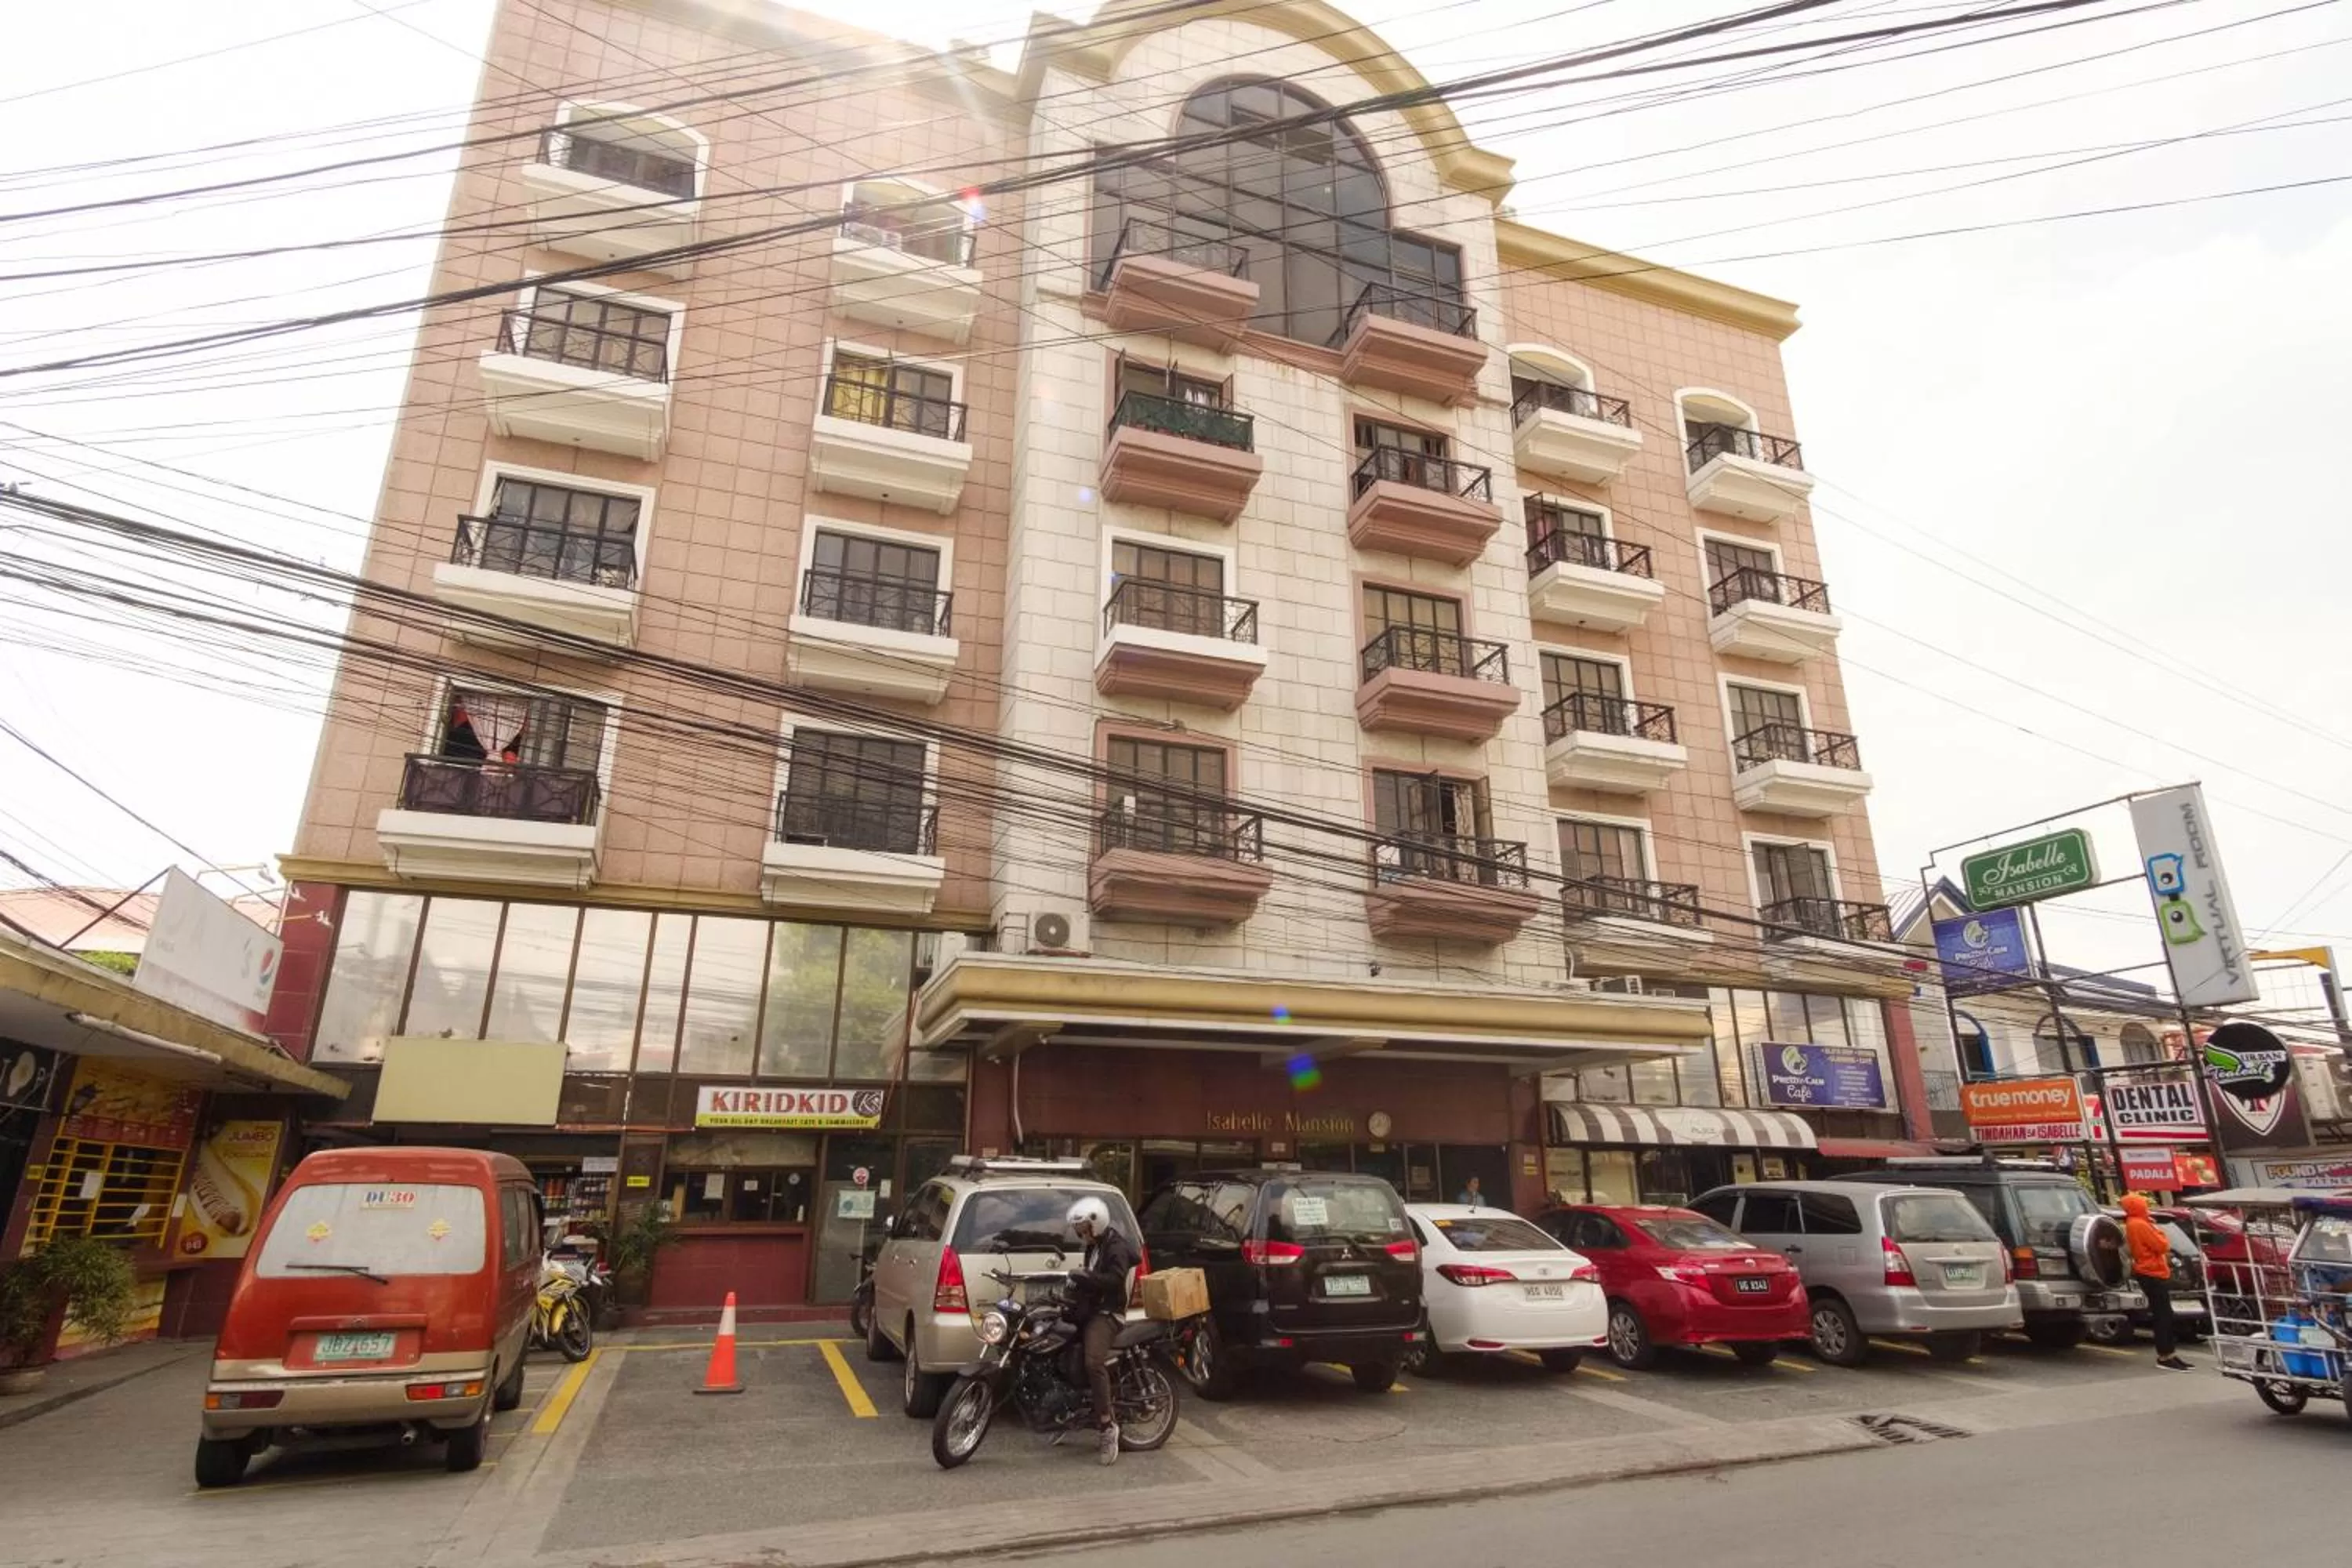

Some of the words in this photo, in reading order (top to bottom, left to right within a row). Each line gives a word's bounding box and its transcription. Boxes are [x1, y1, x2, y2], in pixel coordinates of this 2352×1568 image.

[1982, 841, 2067, 885] Isabelle
[1994, 874, 2063, 898] MANSION
[2240, 1052, 2283, 1062] URBAN
[710, 1091, 848, 1114] KIRIDKID
[1969, 1087, 2071, 1107] truemoney
[2111, 1083, 2194, 1111] DENTAL
[1207, 1110, 1272, 1131] Isabelle
[1286, 1112, 1355, 1133] Mansion
[2118, 1109, 2194, 1124] CLINIC
[228, 1131, 274, 1142] JUMBO
[1974, 1124, 2027, 1142] TINDAHAN
[2038, 1123, 2082, 1138] ISABELLE
[2129, 1169, 2173, 1180] PADALA
